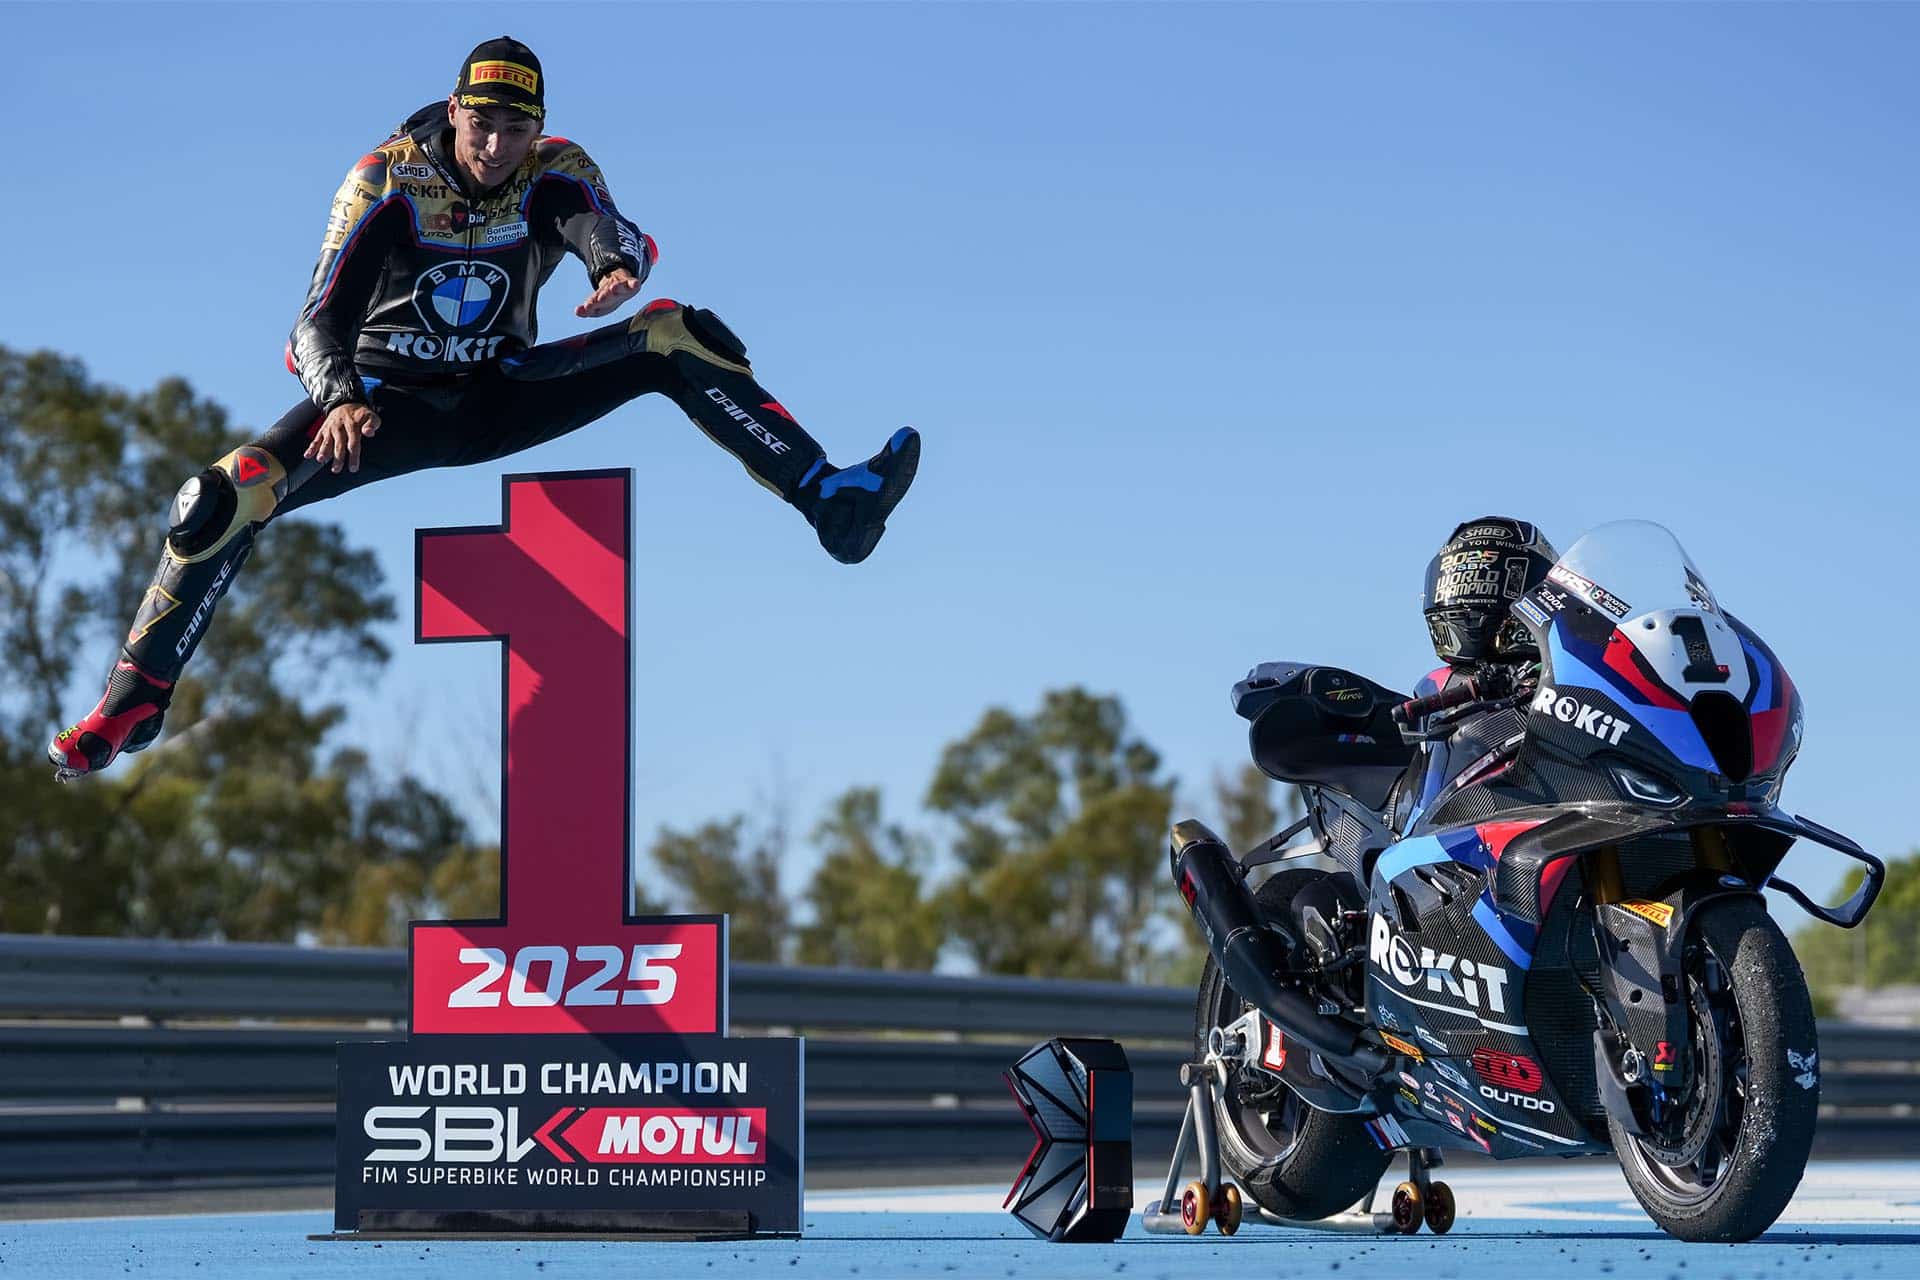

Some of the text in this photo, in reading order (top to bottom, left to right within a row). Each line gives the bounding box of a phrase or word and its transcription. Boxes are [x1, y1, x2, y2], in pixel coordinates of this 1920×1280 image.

[475, 65, 534, 89] PIRELLI
[397, 165, 429, 178] SHOEI
[429, 265, 502, 285] BMW
[705, 387, 792, 455] DAINESE
[1464, 527, 1506, 539] SHOEI
[1440, 550, 1500, 572] 2025
[1436, 571, 1500, 593] WORLD
[175, 560, 233, 657] DAINESE
[448, 943, 683, 1008] 2025
[388, 1062, 747, 1096] WORLD CHAMPION
[1480, 1085, 1555, 1113] OUTDO
[598, 1115, 758, 1156] MOTUL
[362, 1167, 767, 1188] FIM SUPERBIKE WORLD CHAMPIONSHIP
